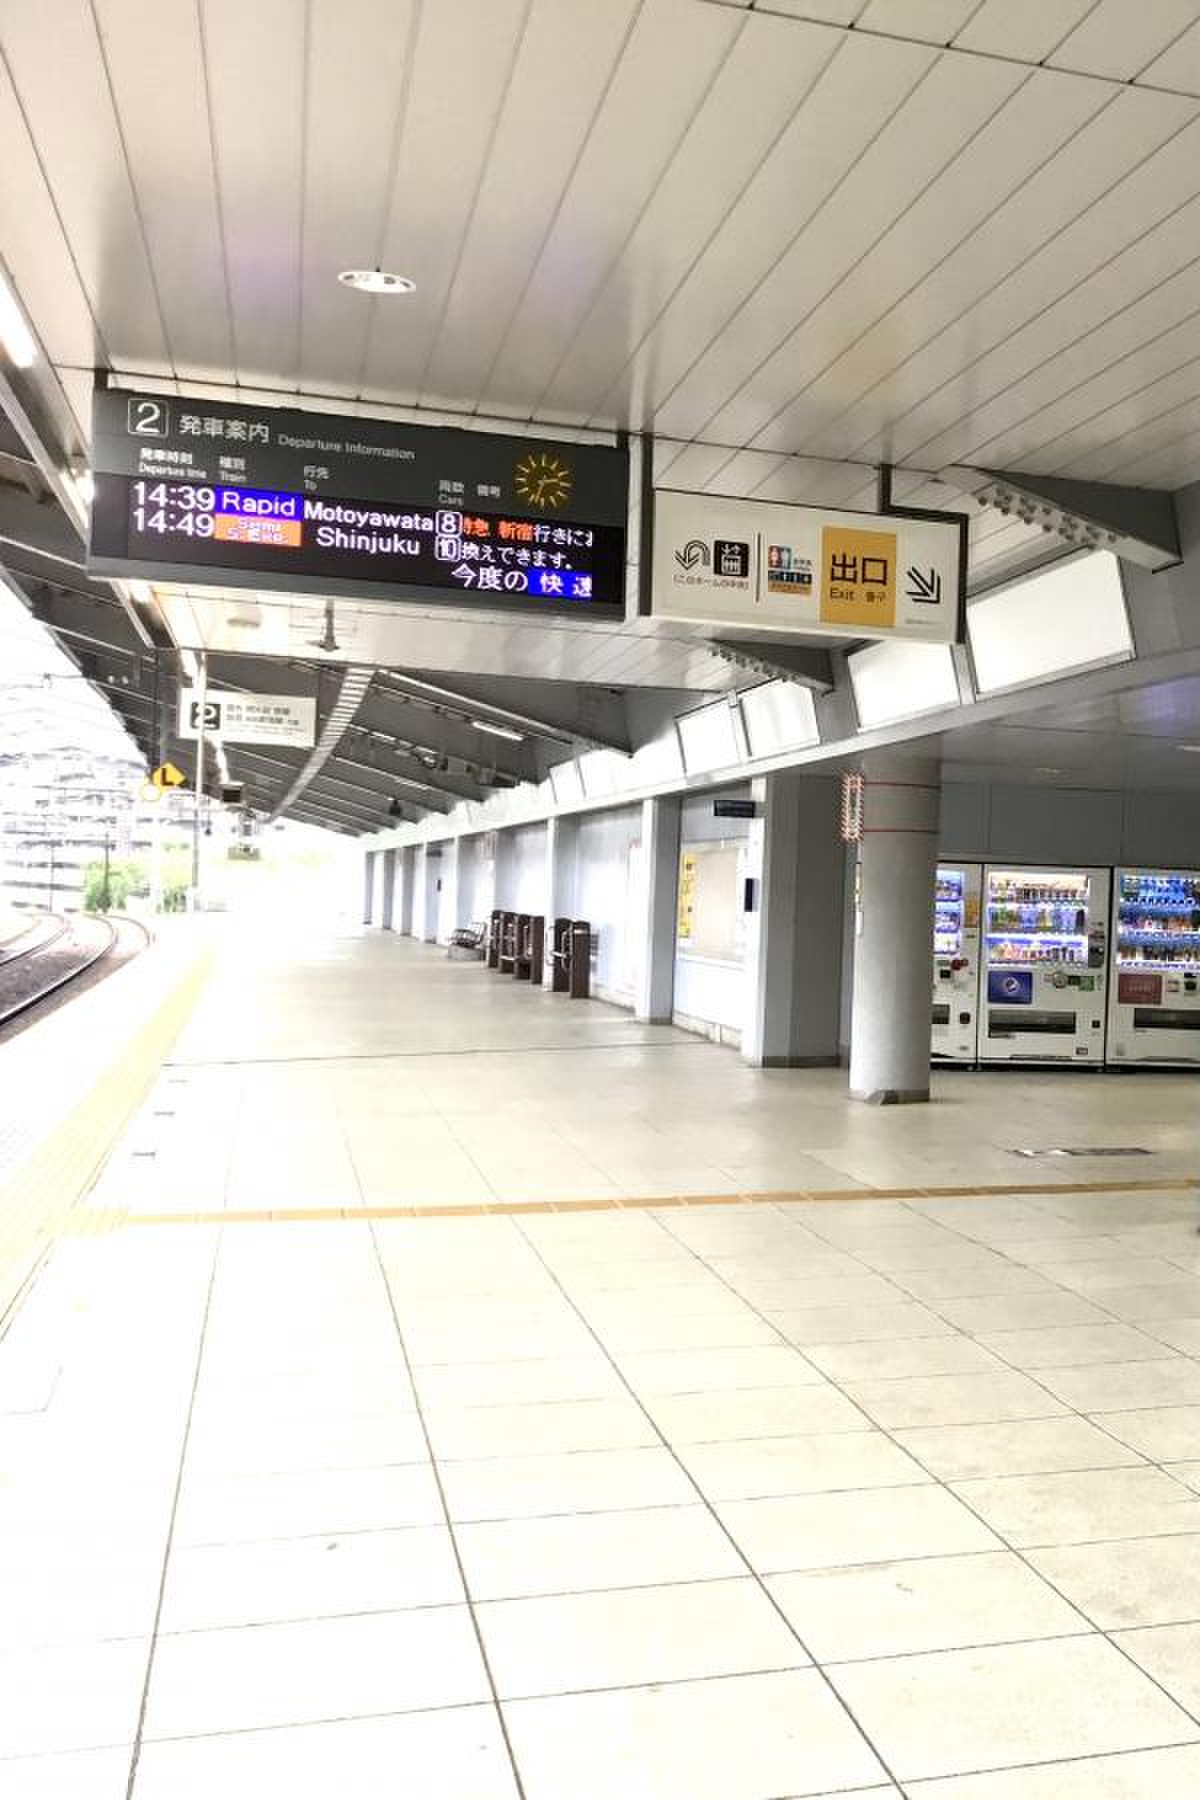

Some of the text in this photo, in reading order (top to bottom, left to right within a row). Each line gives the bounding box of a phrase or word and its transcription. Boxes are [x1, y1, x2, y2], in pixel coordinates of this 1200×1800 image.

[135, 402, 161, 433] 2
[179, 415, 270, 443] 発車案内
[278, 434, 416, 460] Departure Information
[133, 480, 457, 534] 14:39 Rapid Motoyawata 8
[133, 507, 216, 538] 14:49
[316, 526, 457, 559] Shinjuku 10
[450, 563, 529, 592] 今度の
[831, 553, 888, 586] 出口
[829, 587, 854, 601] Exit
[195, 704, 217, 729] 2
[160, 768, 175, 786] L
